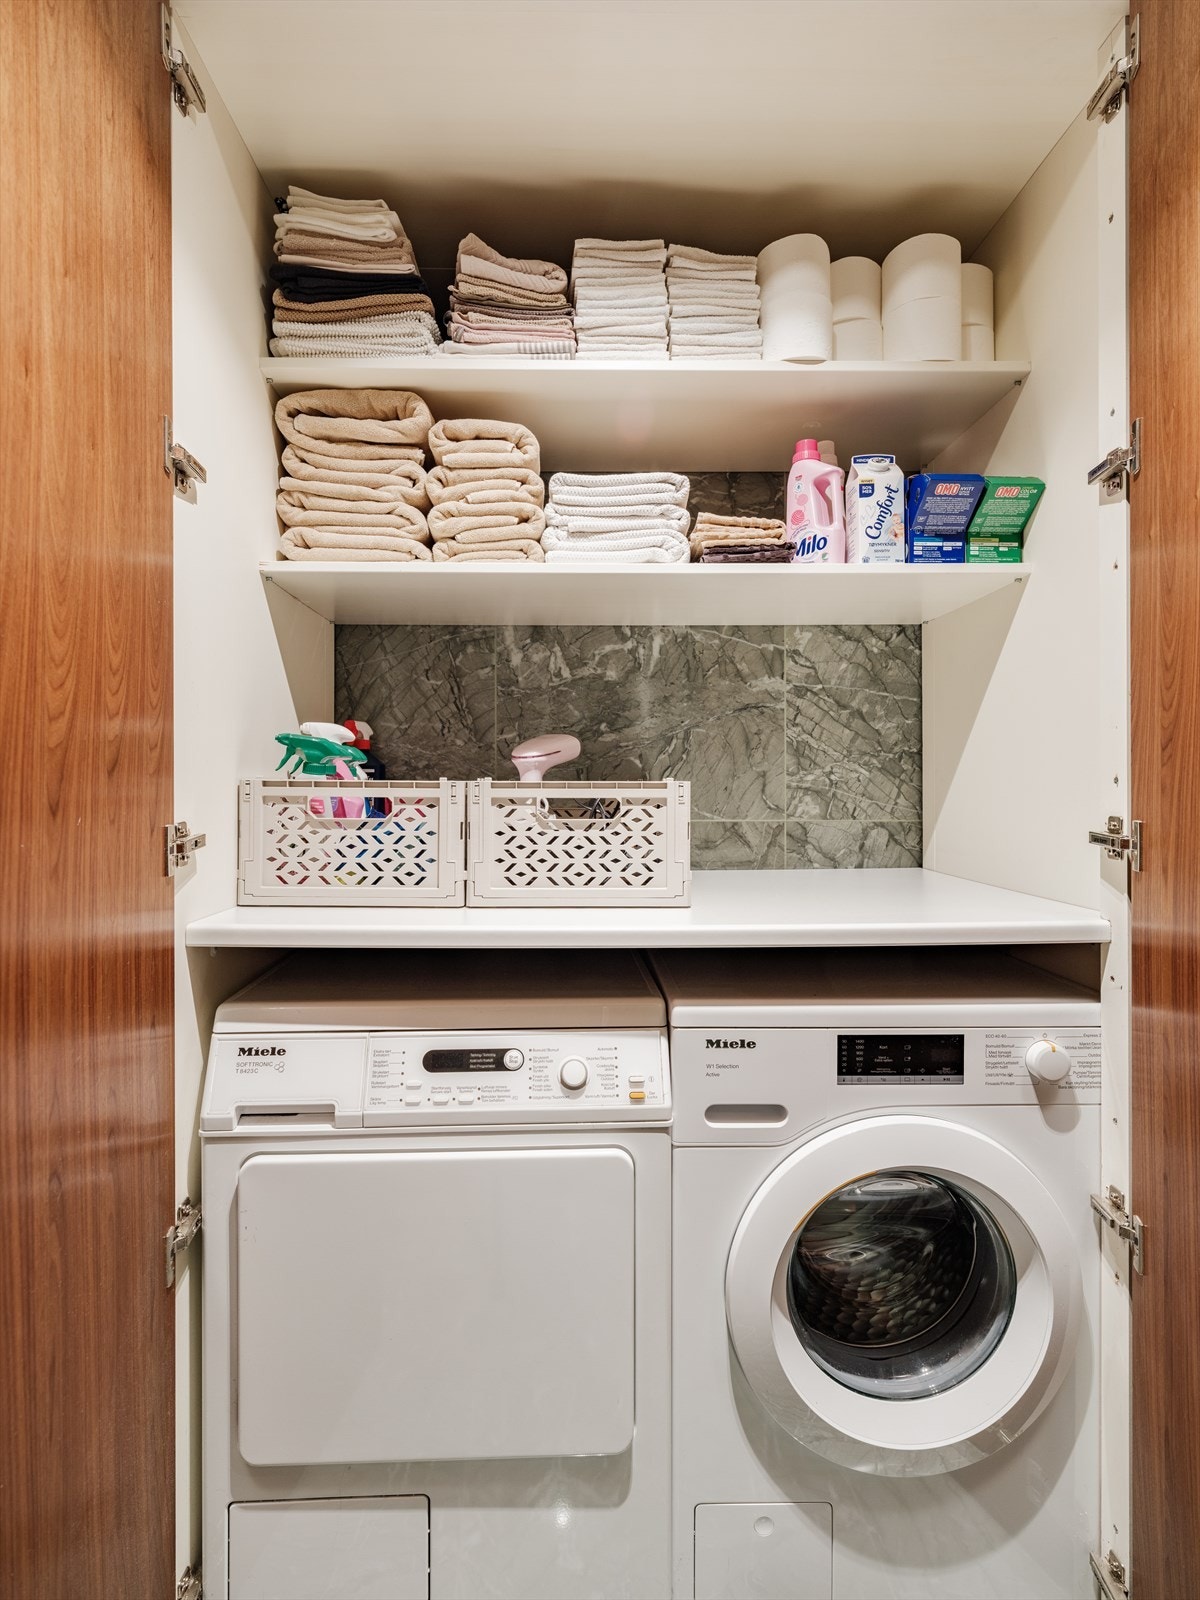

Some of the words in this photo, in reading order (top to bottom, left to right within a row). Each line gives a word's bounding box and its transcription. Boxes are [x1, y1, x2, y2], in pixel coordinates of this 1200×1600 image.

[935, 483, 961, 496] OMO
[995, 486, 1021, 498] OMO
[864, 483, 899, 540] Comfort
[793, 534, 828, 559] Milo
[705, 1038, 757, 1049] Miele
[237, 1046, 287, 1057] Miele
